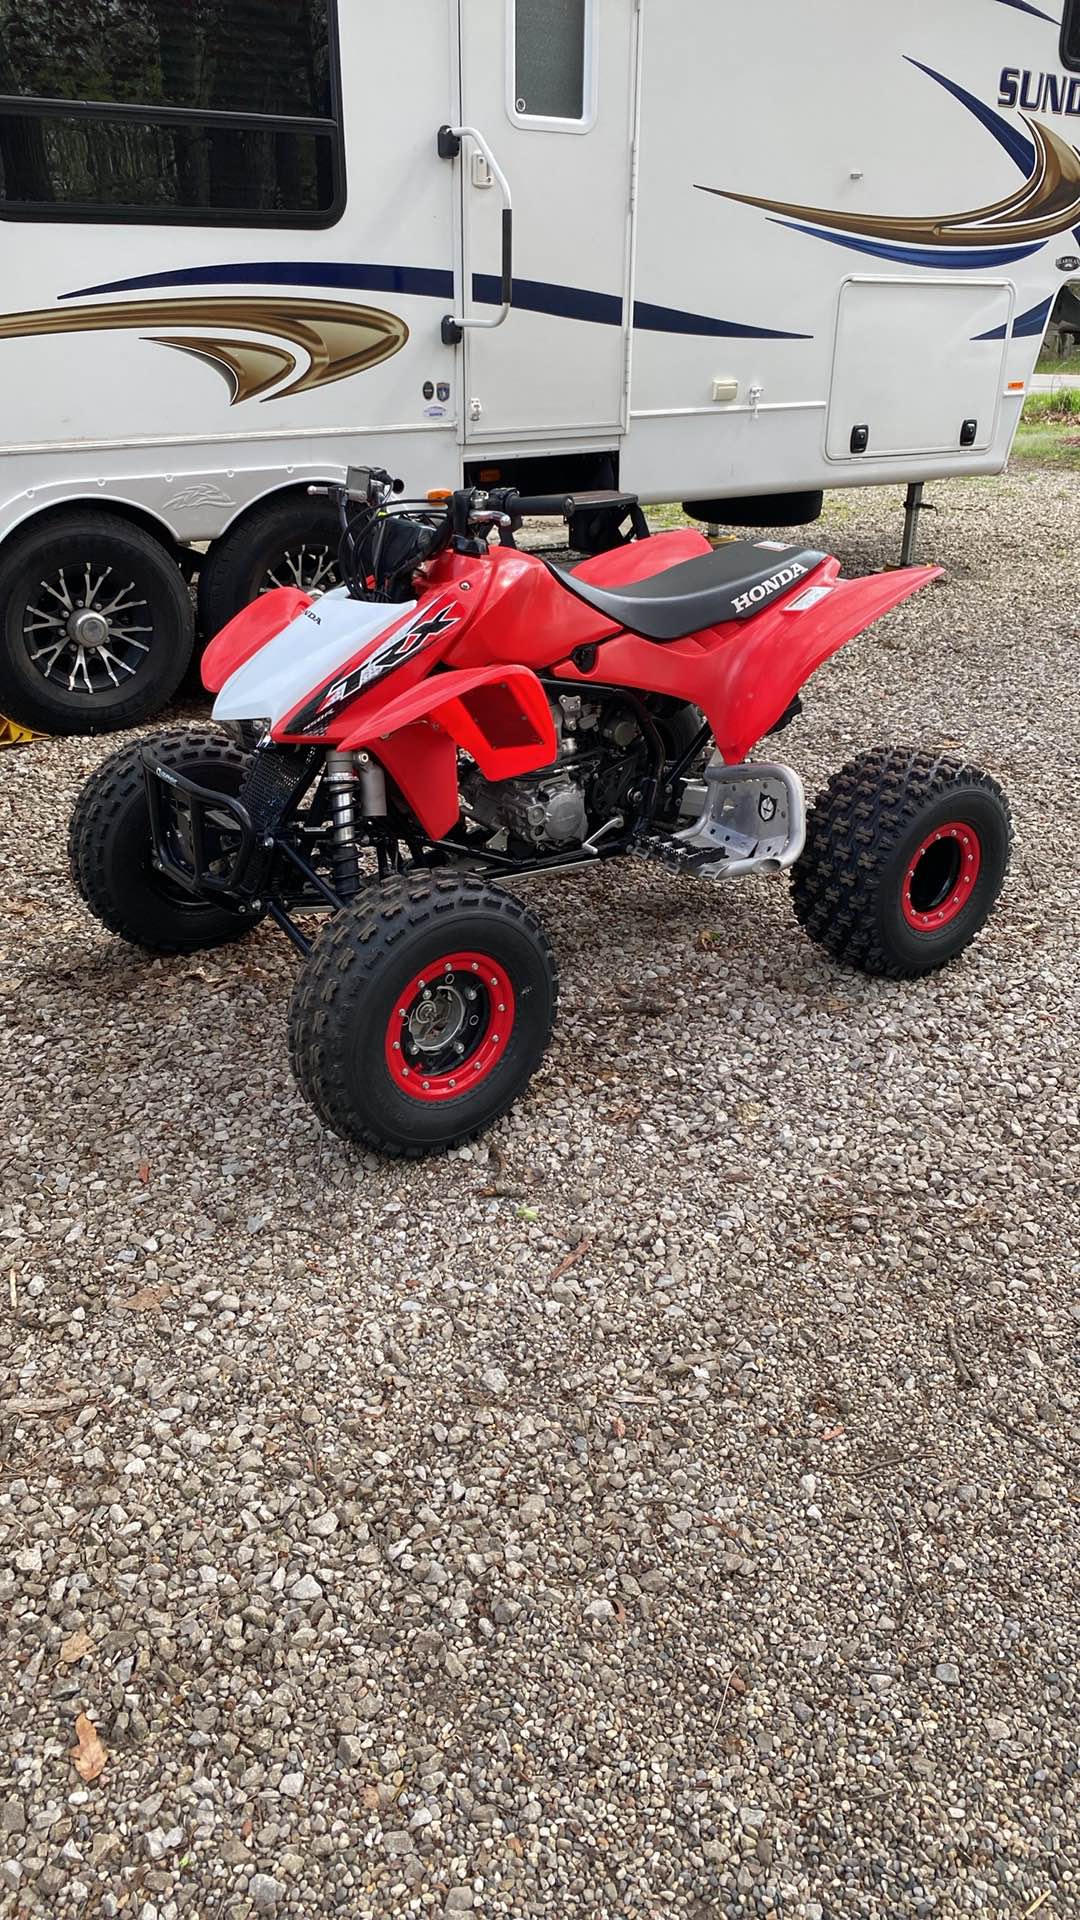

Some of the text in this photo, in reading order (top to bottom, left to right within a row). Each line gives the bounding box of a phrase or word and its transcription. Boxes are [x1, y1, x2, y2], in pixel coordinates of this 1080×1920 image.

[731, 563, 808, 613] HONDA
[304, 609, 321, 626] NDA
[325, 600, 461, 701] TRX
